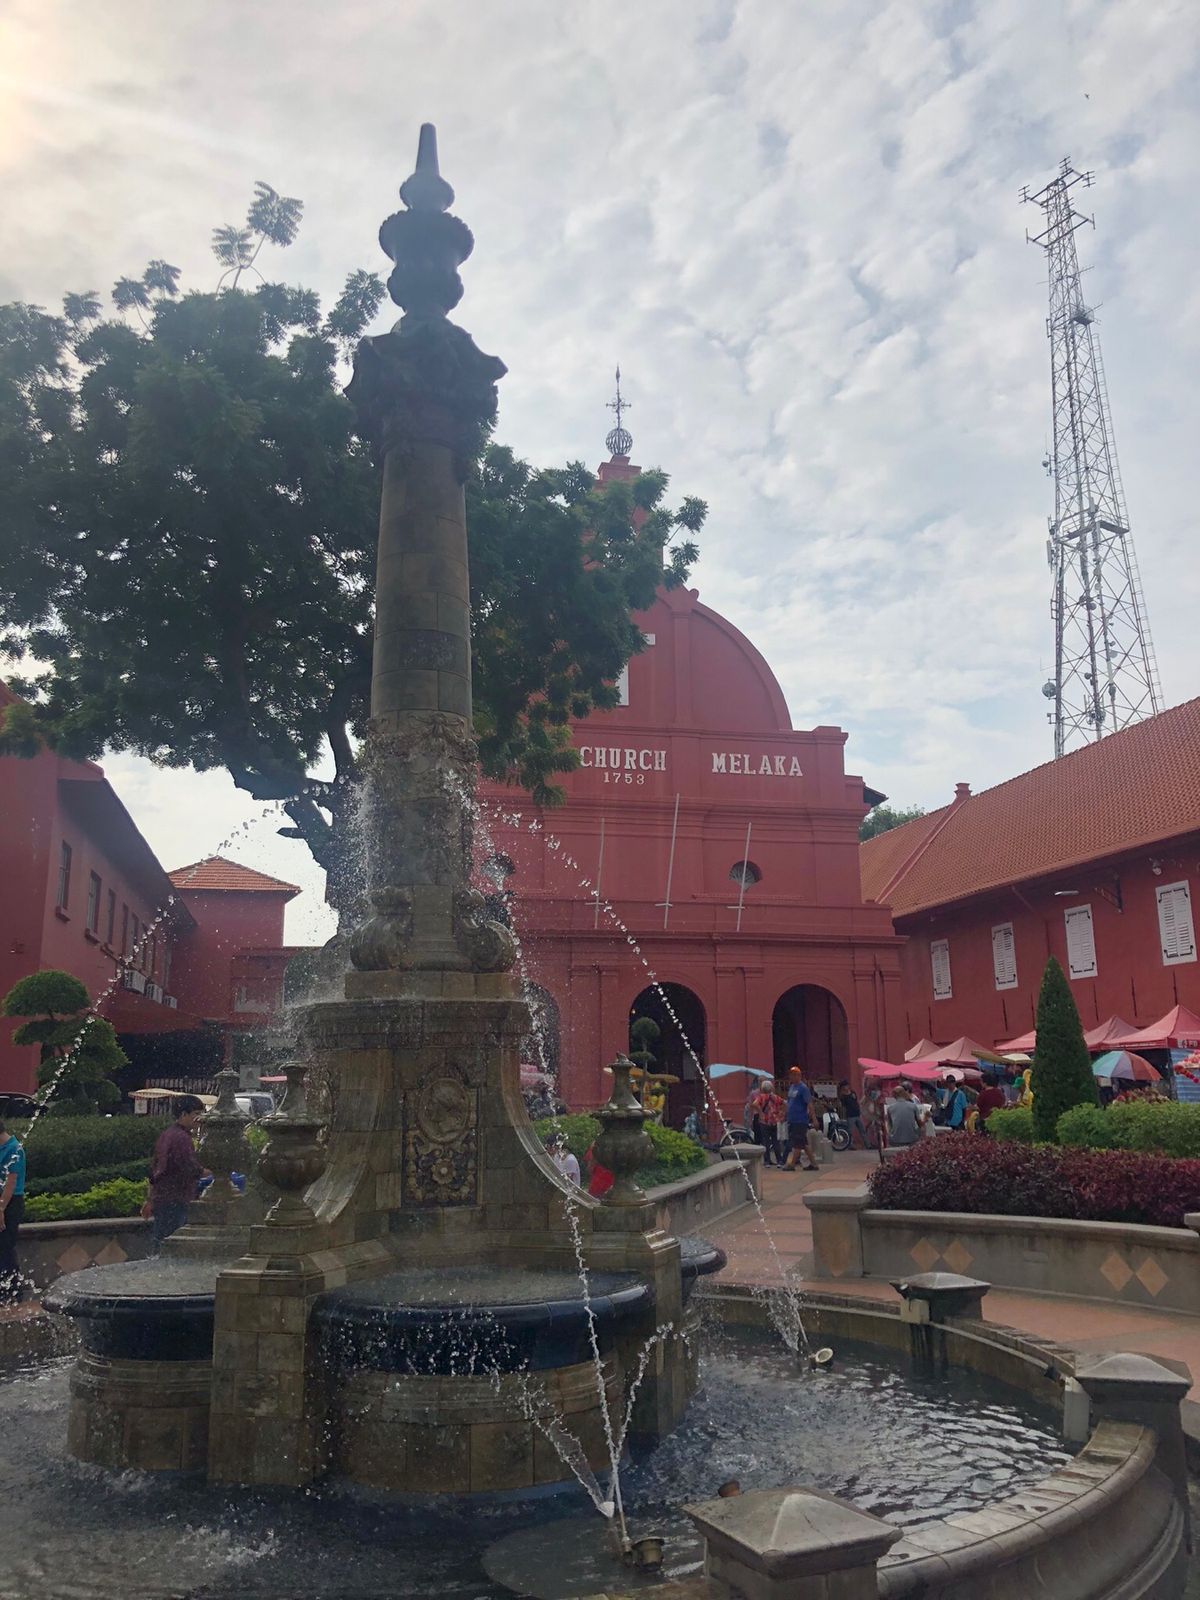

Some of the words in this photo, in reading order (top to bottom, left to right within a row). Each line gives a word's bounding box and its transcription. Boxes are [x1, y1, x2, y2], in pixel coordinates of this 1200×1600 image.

[580, 746, 666, 771] CHURCH
[711, 752, 803, 777] MELAKA
[603, 772, 645, 785] 1753
